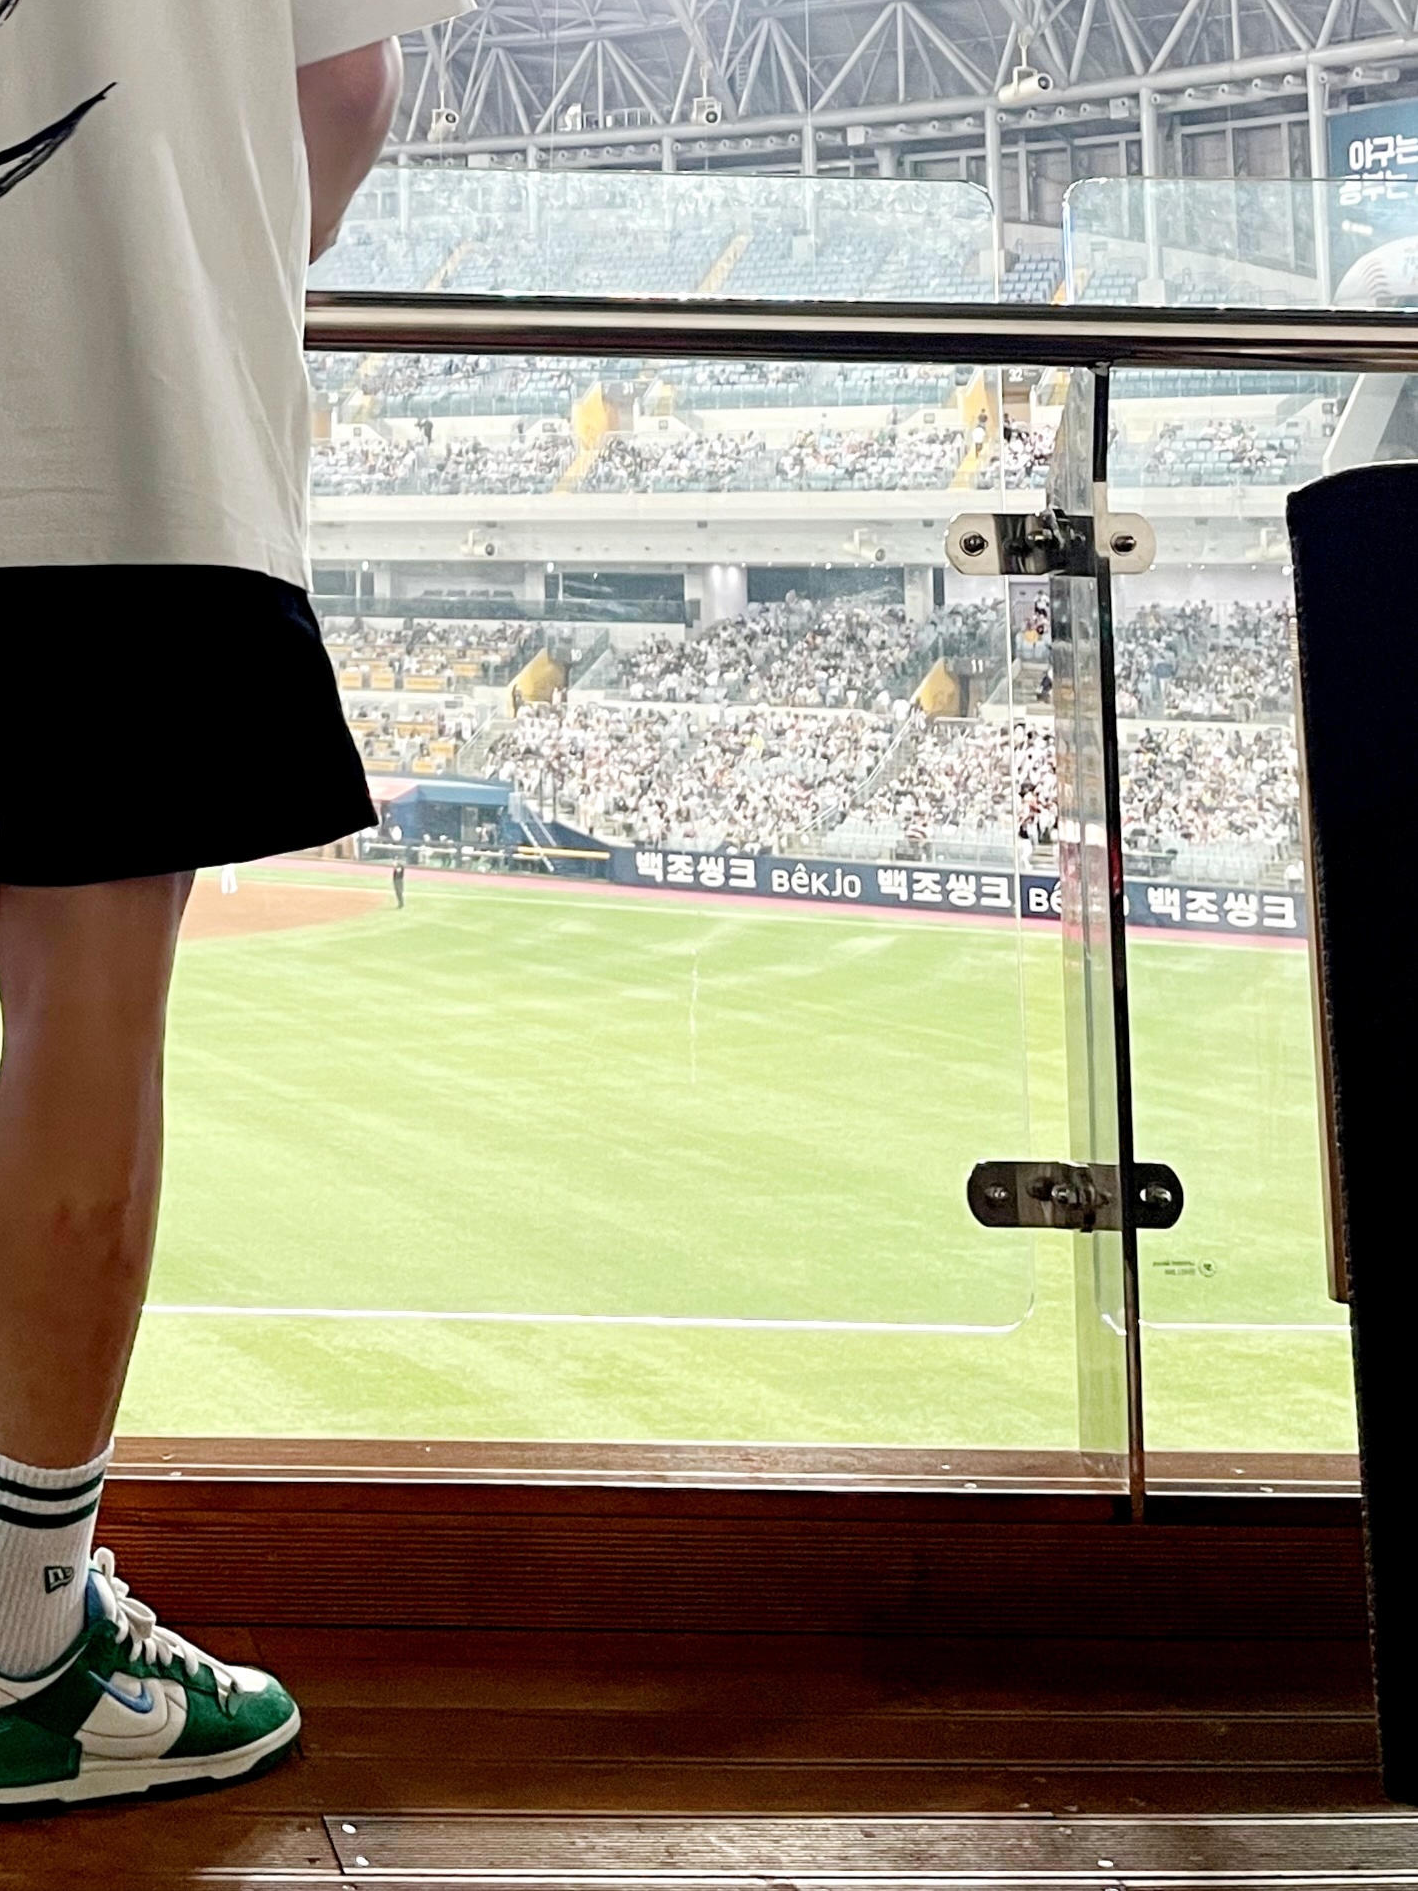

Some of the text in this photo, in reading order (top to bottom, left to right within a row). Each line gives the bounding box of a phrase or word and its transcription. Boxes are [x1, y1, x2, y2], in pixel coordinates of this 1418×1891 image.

[1348, 134, 1418, 171] 야구는
[1008, 368, 1024, 382] 32
[971, 659, 984, 674] 11
[635, 851, 757, 888] 백조씽크
[877, 868, 1012, 908] 백조씽크
[1147, 887, 1297, 929] 백조씽크
